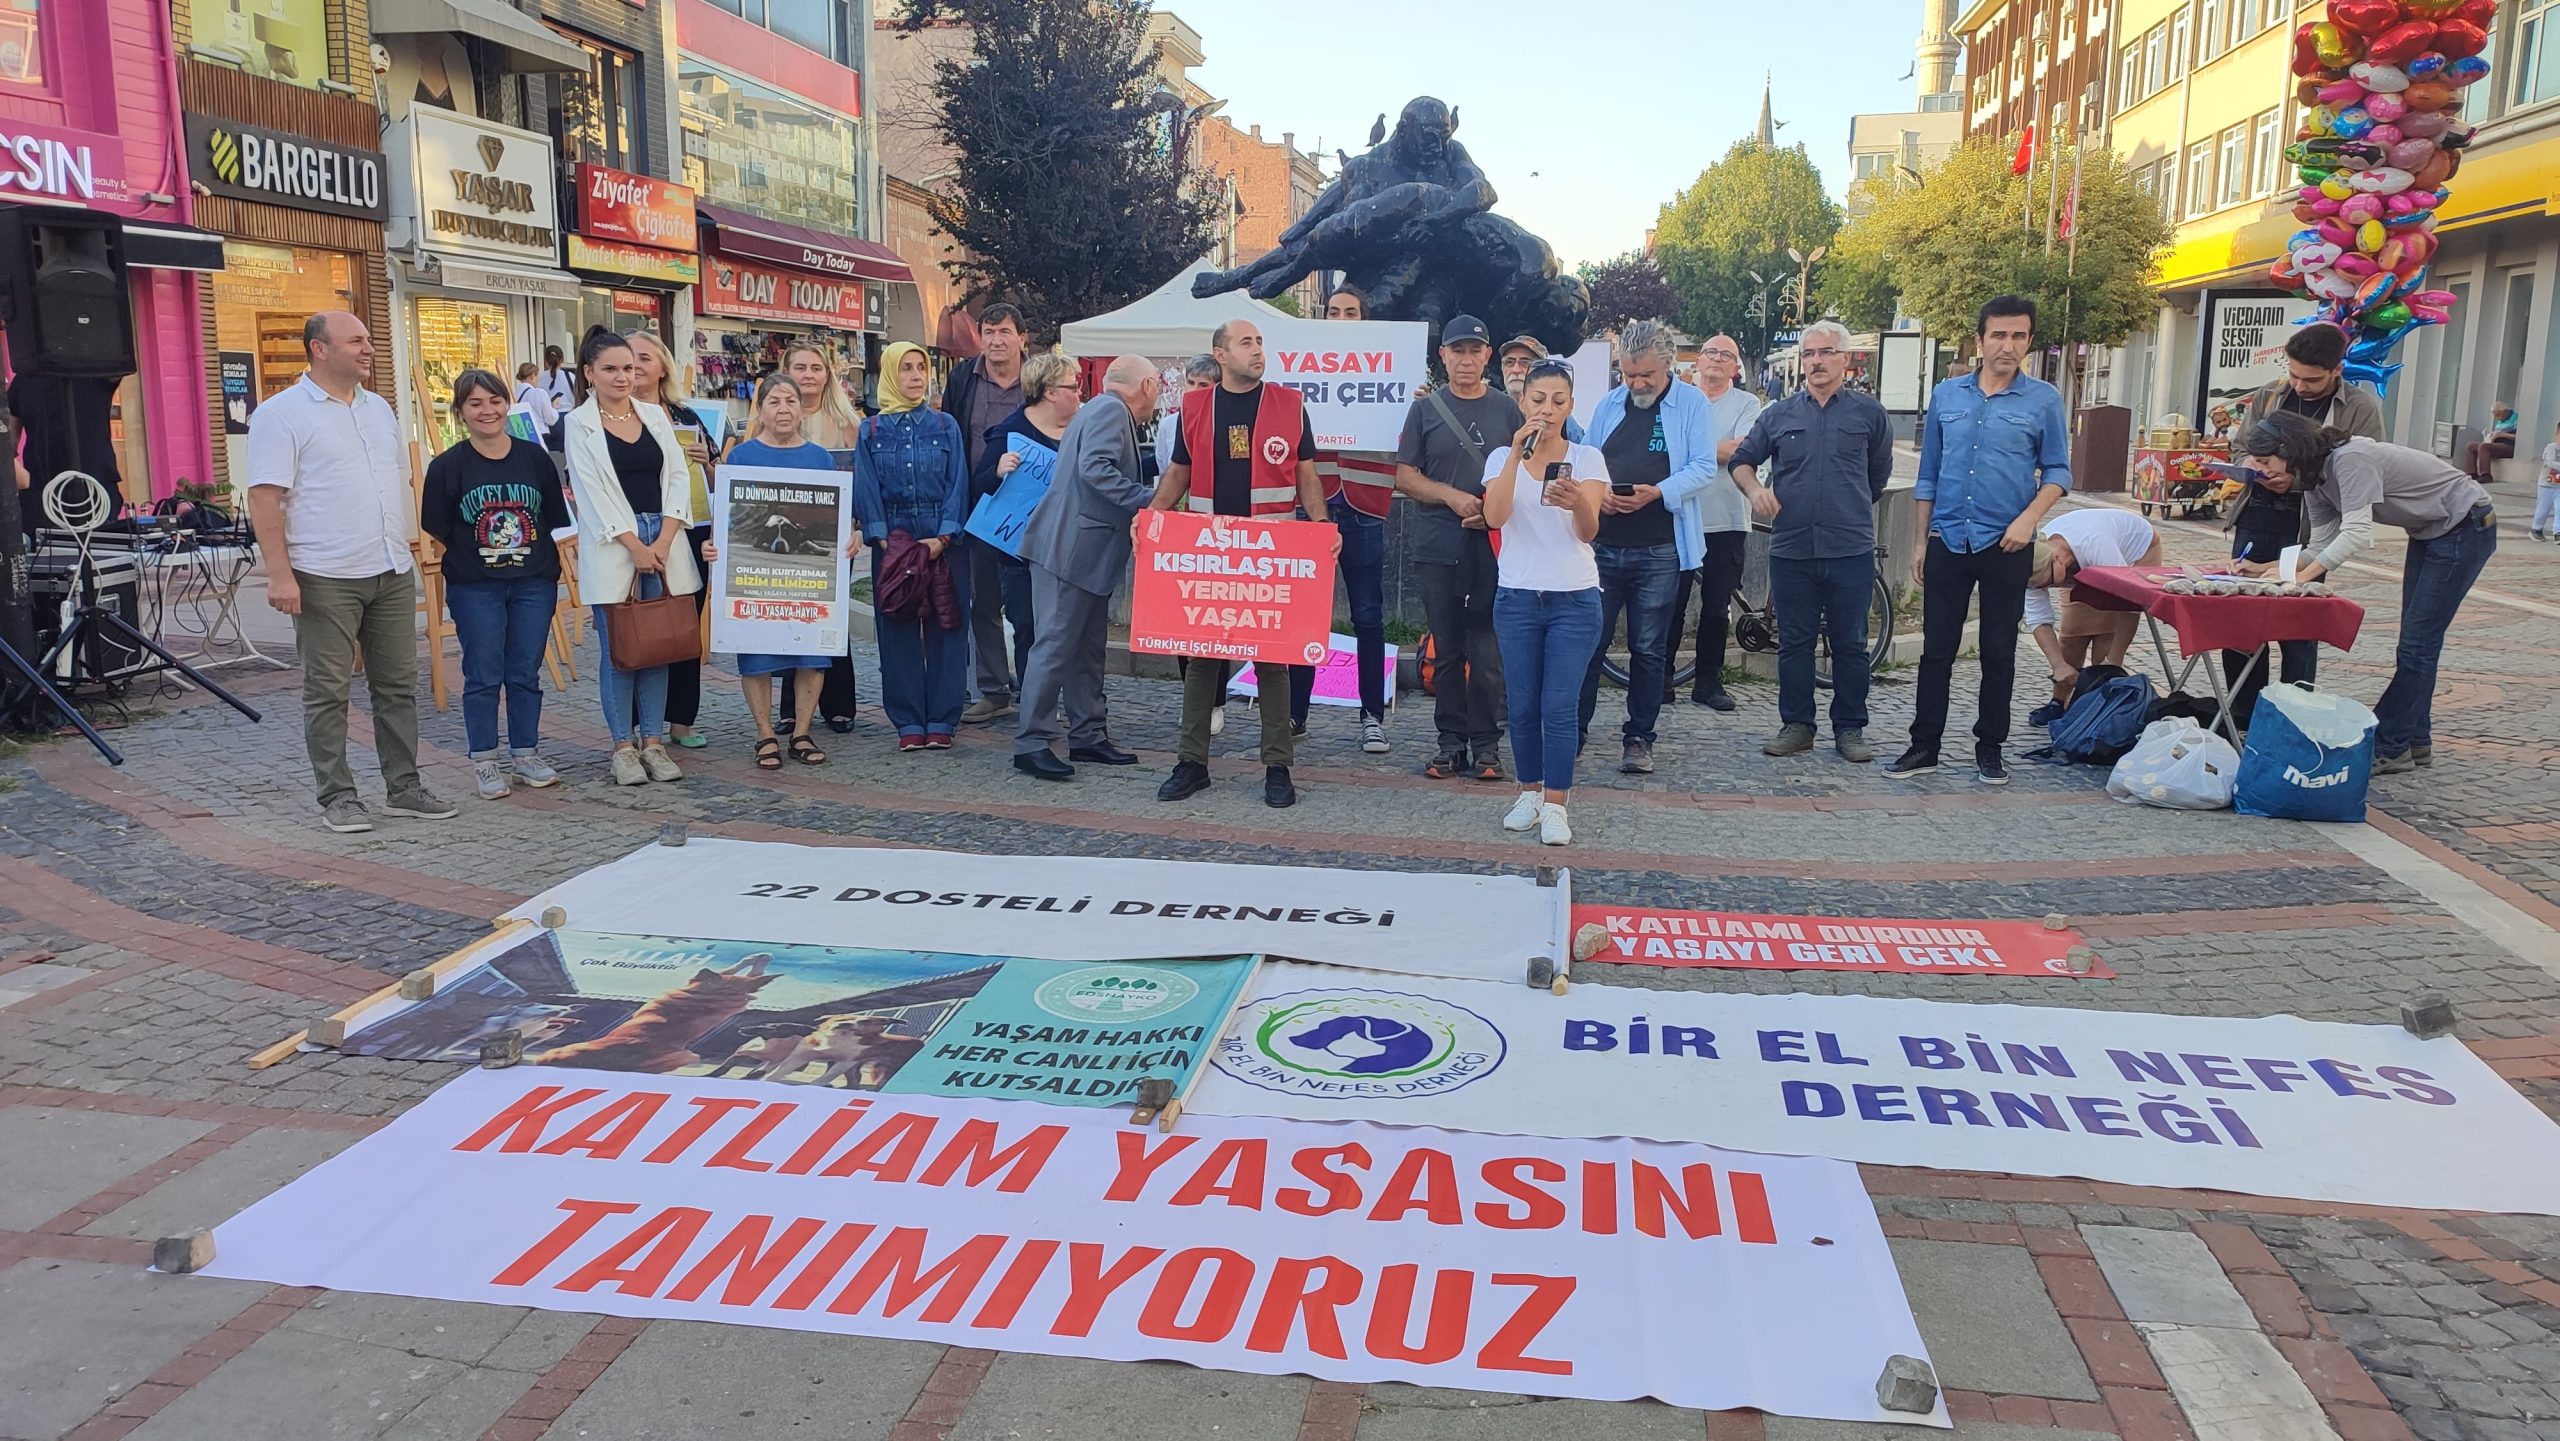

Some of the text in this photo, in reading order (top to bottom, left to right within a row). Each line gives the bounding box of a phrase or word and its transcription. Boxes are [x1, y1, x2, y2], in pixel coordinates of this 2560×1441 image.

[242, 134, 377, 207] BARGELLO
[450, 168, 535, 214] YAŞAR
[592, 171, 649, 208] Ziyafet
[636, 209, 694, 240] Çiğköfte
[573, 241, 615, 266] Ziyafet
[619, 250, 661, 272] Çiğköfte
[802, 249, 855, 273] Day Today
[486, 274, 546, 293] ERCAN YAŞAR
[740, 272, 777, 304] DAY
[789, 280, 843, 313] TODAY
[1279, 352, 1393, 373] YASAYI
[2219, 349, 2250, 368] DUY!
[1337, 382, 1406, 407] ÇEK!
[1317, 435, 1357, 446] PARTİSİ
[460, 484, 502, 525] MICKEY
[734, 486, 744, 500] BU
[745, 484, 778, 502] DÜNYADA
[780, 486, 813, 504] BİZLERDE
[1195, 528, 1276, 552] AŞILA
[736, 566, 828, 578] ONLARI KURTARMAK
[1153, 552, 1316, 580] KISIRLAŞTIR
[735, 574, 768, 587] BİZİM
[740, 603, 818, 619] KANLI YASAYA HAYIR
[1184, 606, 1282, 630] YAŞAT!
[1137, 637, 1258, 657] TÜRKİYE İŞÇİ PARTİSİ
[2283, 765, 2349, 788] mavi
[738, 883, 1395, 928] 22 DOSTELİ DERNEĞİ
[1605, 915, 1992, 946] KATLİAMI DURDUR
[1612, 936, 1775, 962] YASAYI
[1788, 943, 1887, 964] GERİ
[580, 958, 610, 968] Çok
[971, 1021, 1204, 1046] YAŞAM HAKKI
[933, 1043, 1190, 1073] HER CANLI İÇİN
[1563, 1016, 2457, 1106] BİR EL BİN NEFES
[1298, 1079, 1388, 1093] NEFES
[1781, 1080, 2263, 1149] DERNEĞİ
[451, 1085, 1778, 1245] KATLİAM YASASINI
[489, 1198, 1577, 1376] TANIMIYORUZ
